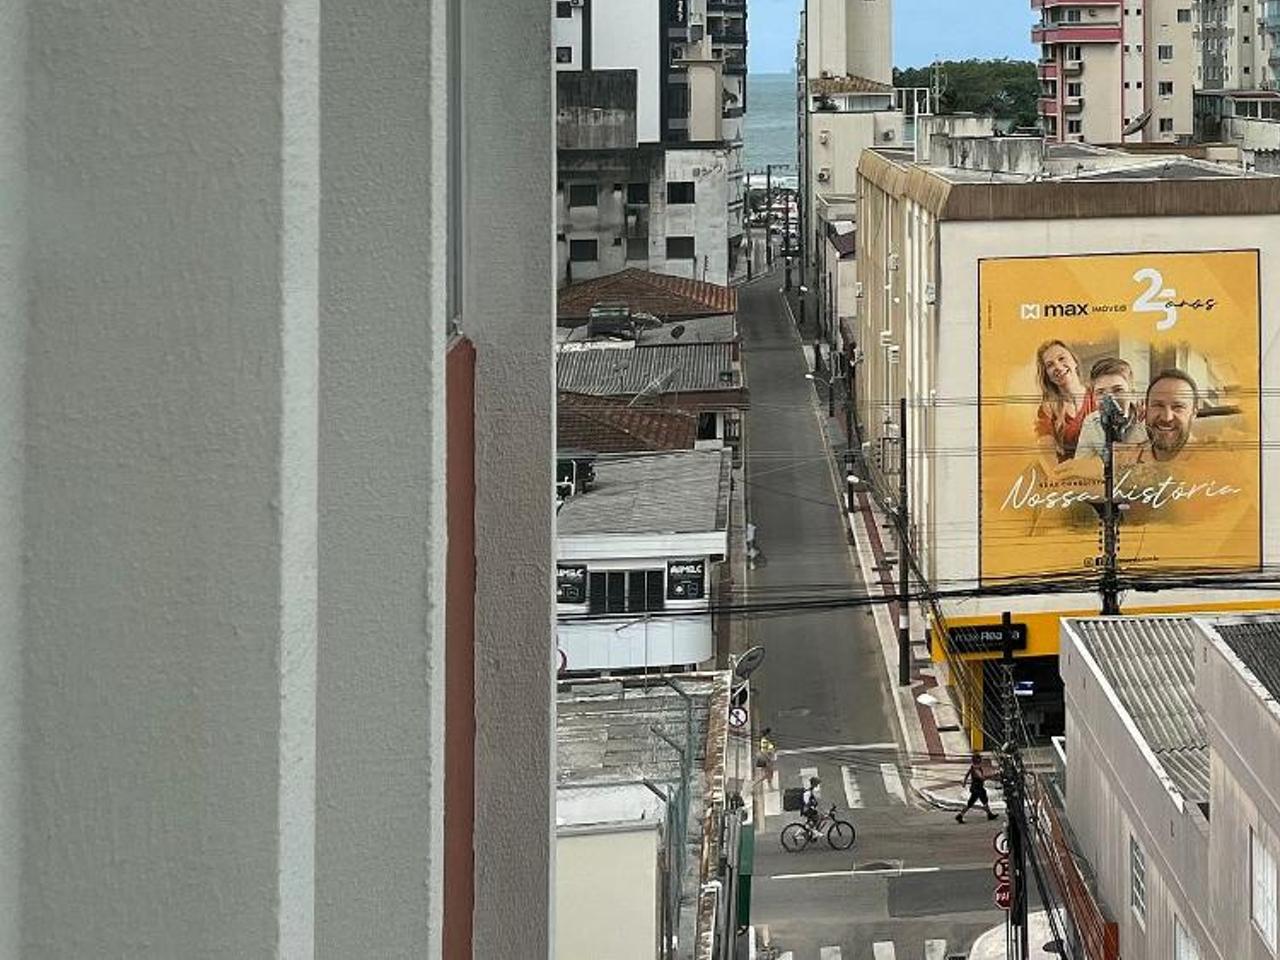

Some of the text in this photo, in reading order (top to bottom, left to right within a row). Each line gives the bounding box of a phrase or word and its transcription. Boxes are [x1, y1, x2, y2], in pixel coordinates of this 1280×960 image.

[1043, 302, 1089, 317] max
[1132, 267, 1178, 331] 25
[1001, 469, 1099, 510] Nossa
